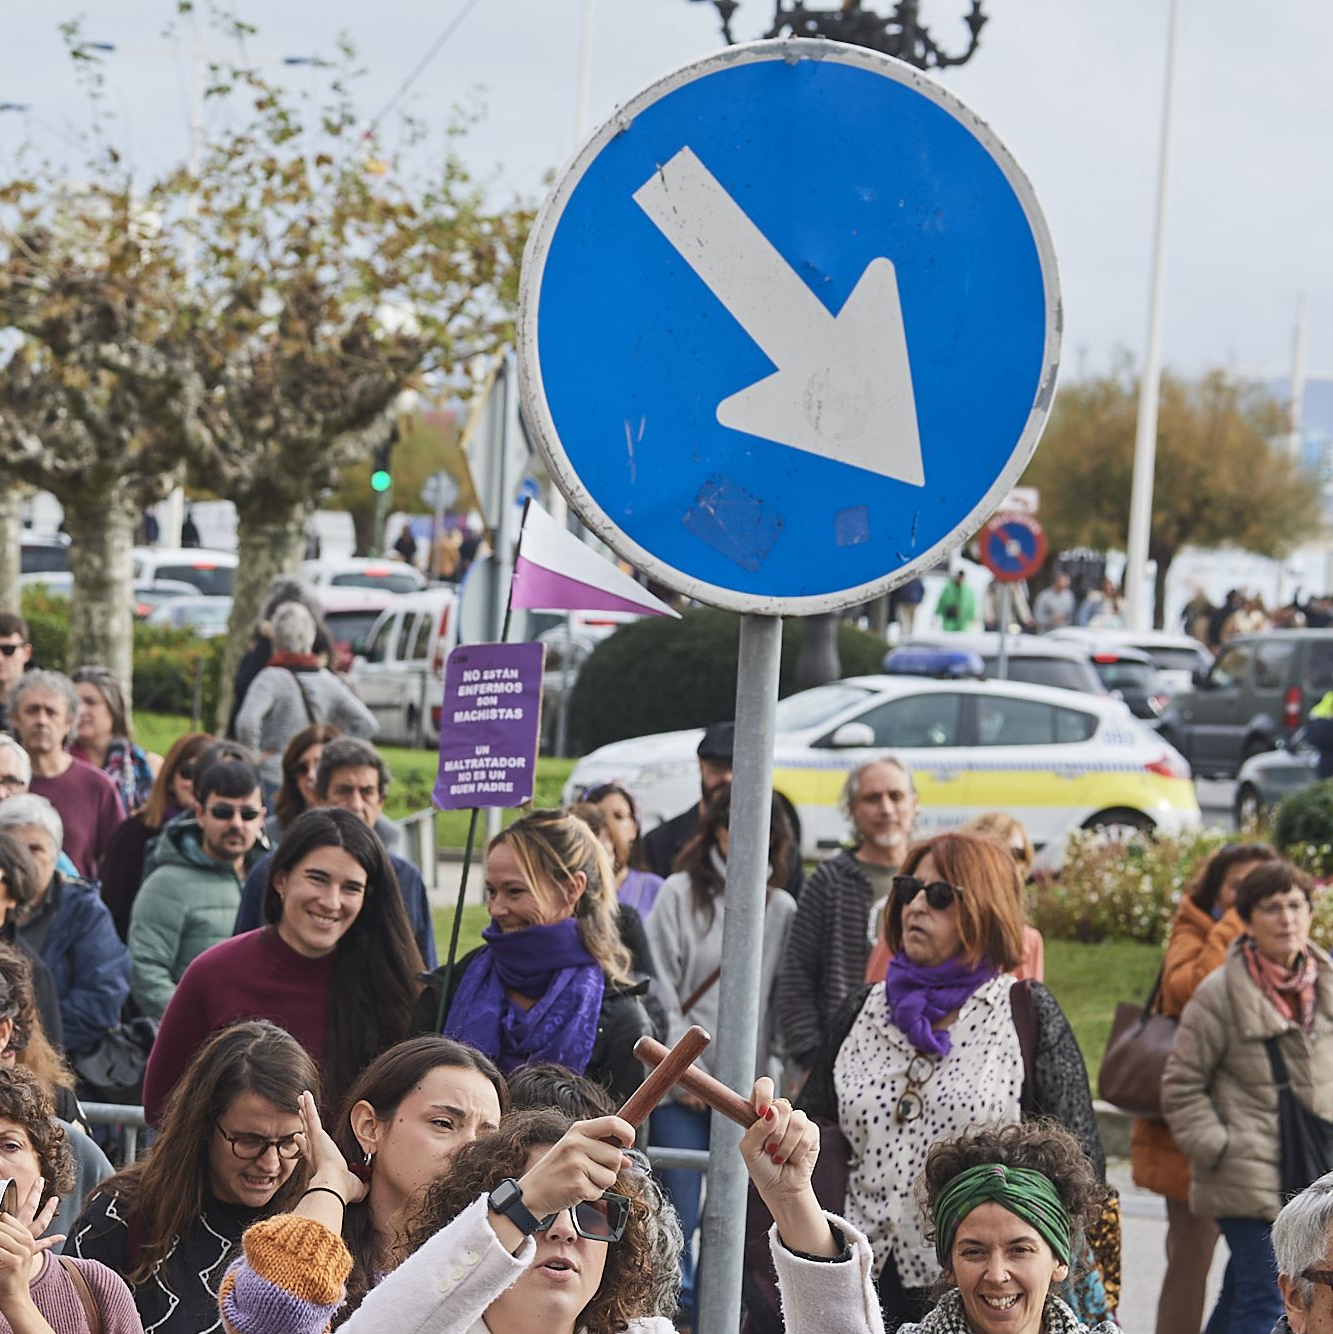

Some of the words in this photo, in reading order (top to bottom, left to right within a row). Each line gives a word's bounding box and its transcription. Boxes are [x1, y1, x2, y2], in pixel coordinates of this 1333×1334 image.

[463, 670, 481, 682] NO
[458, 682, 523, 697] ENFERMOS
[476, 696, 498, 707] SON
[454, 708, 523, 723] MACHISTAS
[475, 745, 490, 755] UN
[444, 757, 526, 772] MALTRATADOR
[458, 771, 471, 782] NO
[473, 770, 486, 781] ES
[488, 769, 506, 780] UN
[450, 784, 476, 795] BUEN
[476, 781, 513, 793] PADRE
